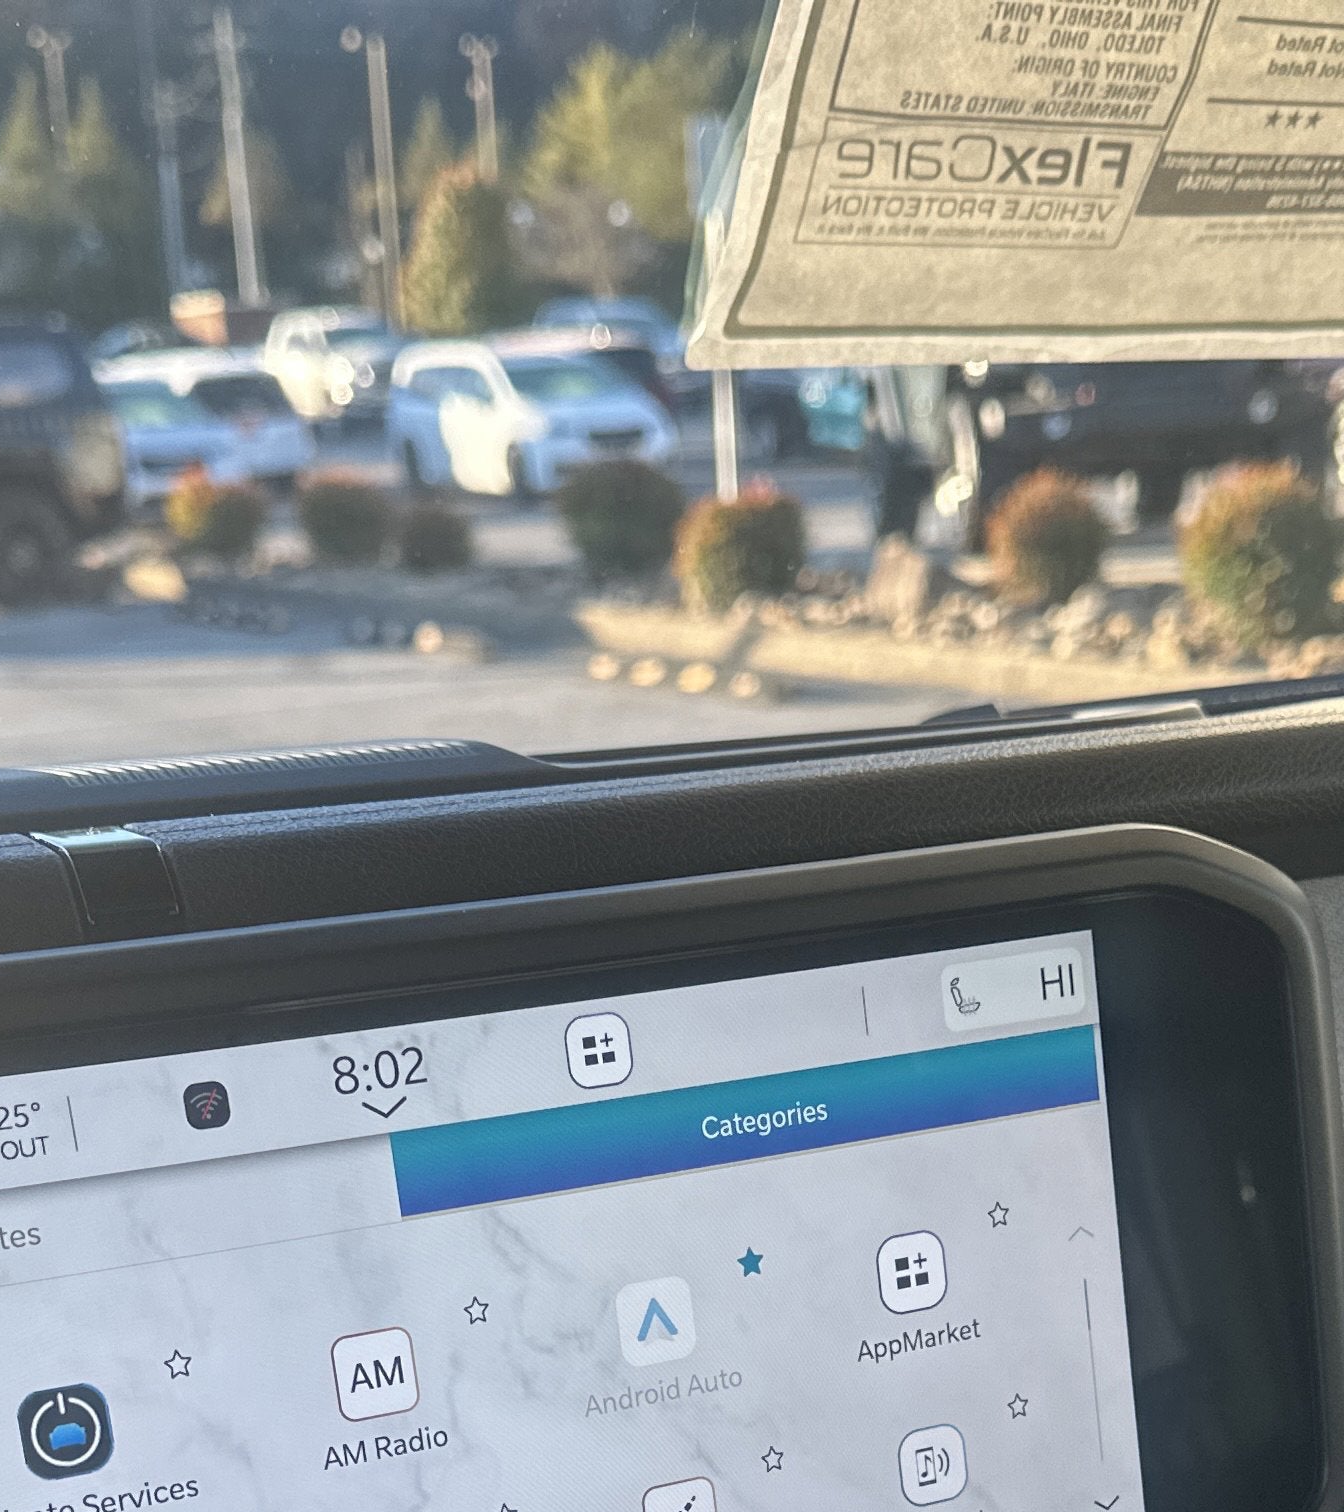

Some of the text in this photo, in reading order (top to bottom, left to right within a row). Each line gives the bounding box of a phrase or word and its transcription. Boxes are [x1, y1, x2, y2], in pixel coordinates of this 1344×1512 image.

[1039, 962, 1076, 1002] HI
[331, 1046, 429, 1097] 8:02
[700, 1100, 828, 1140] Categories
[0, 1135, 50, 1161] OUT
[856, 1318, 981, 1363] AppMarket
[349, 1356, 405, 1393] AM
[584, 1366, 743, 1419] Android Auto
[323, 1425, 450, 1471] AM Radio
